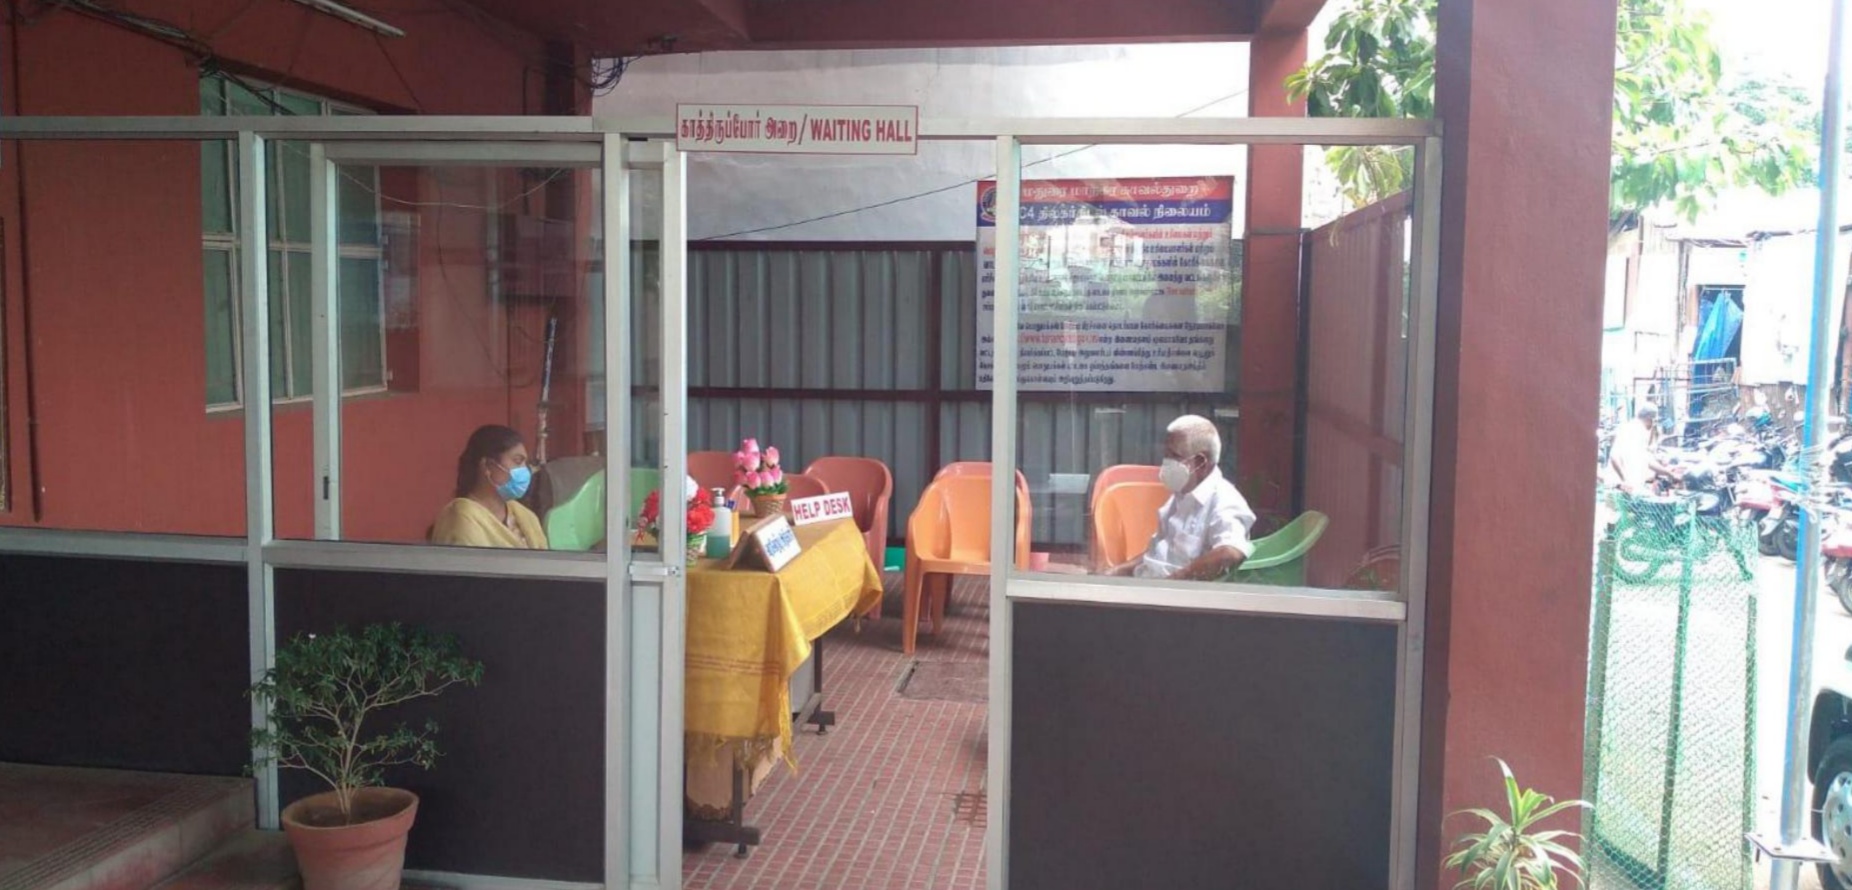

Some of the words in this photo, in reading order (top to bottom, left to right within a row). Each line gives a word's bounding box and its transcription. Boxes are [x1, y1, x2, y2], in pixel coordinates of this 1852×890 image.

[681, 109, 761, 144] காத்திருப்போர்
[810, 118, 872, 142] WAITING
[876, 119, 912, 142] HALL
[1119, 181, 1200, 199] காவல்துறை
[1020, 205, 1035, 220] C4
[1109, 203, 1152, 219] காவல்
[1152, 202, 1212, 221] நிலையம்
[793, 501, 820, 521] HELP
[823, 496, 851, 516] DESK
